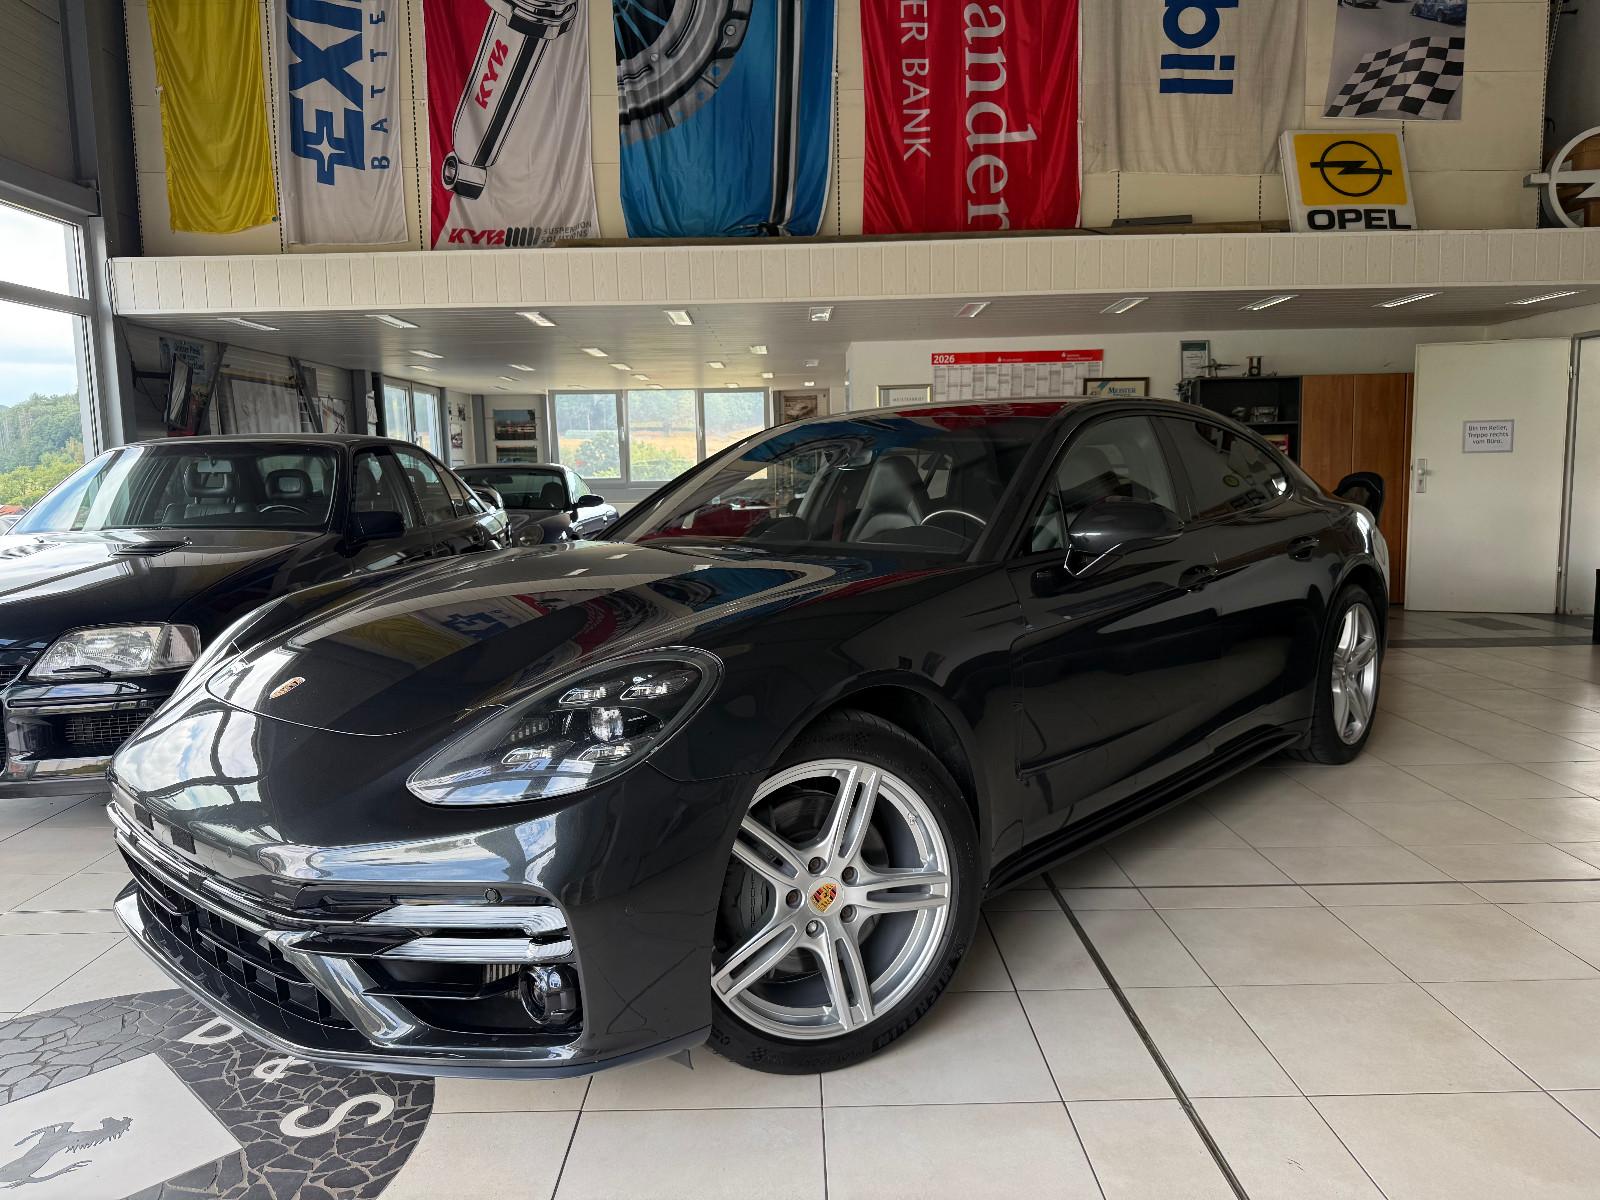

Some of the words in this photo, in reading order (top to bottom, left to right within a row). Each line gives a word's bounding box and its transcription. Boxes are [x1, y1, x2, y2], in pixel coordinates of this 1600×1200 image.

[287, 0, 366, 185] EXI
[370, 10, 391, 170] BATTE
[474, 39, 509, 109] KYB
[1160, 0, 1239, 94] bil
[902, 58, 931, 161] BANK
[964, 3, 1037, 230] ander
[448, 228, 505, 245] KYB
[1307, 209, 1411, 230] OPEL
[933, 354, 955, 364] 2026
